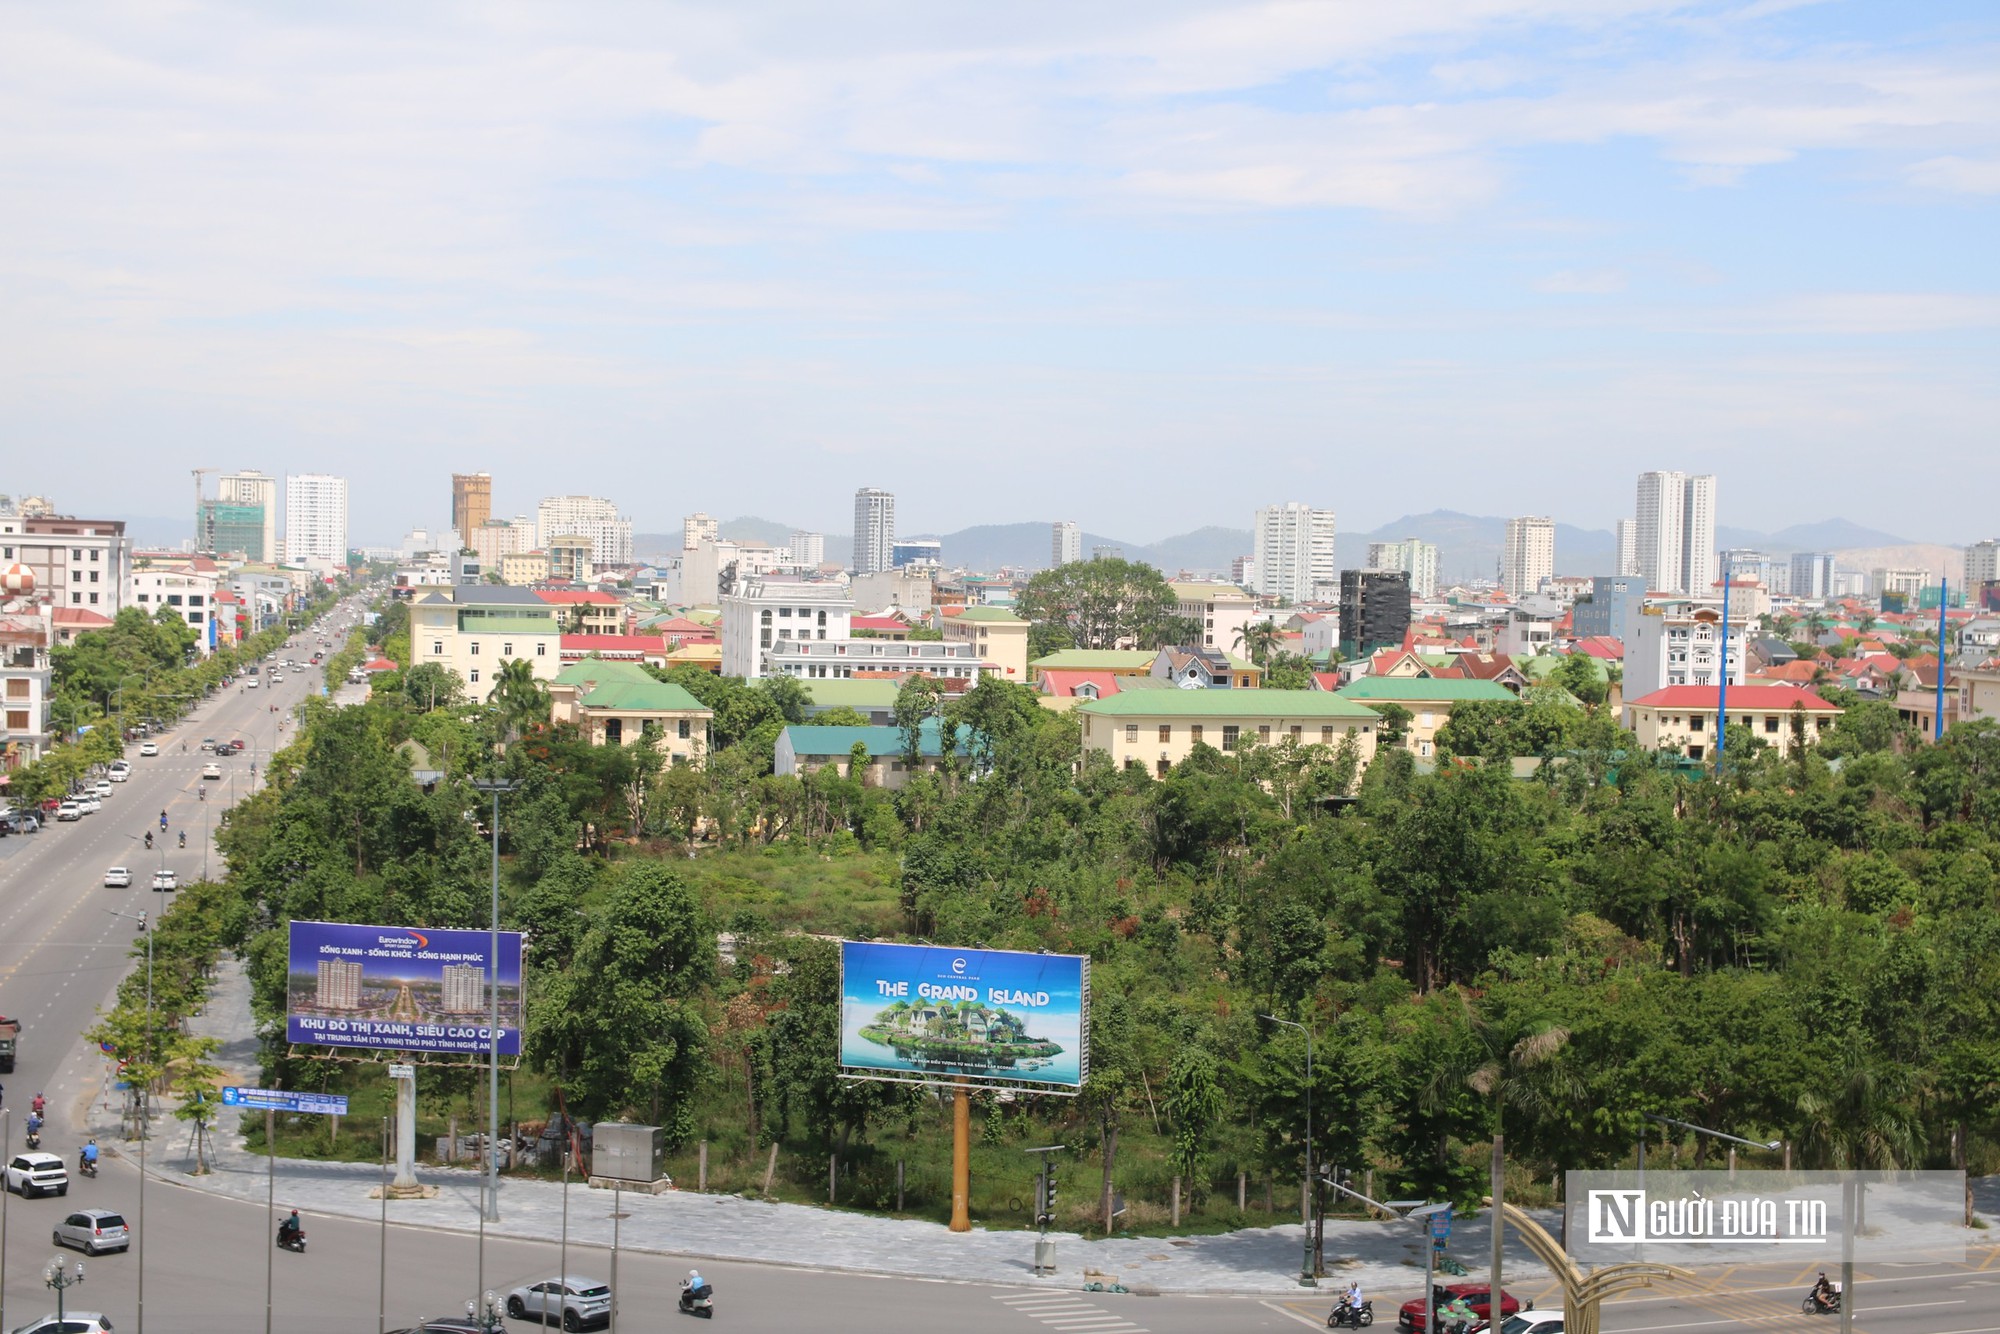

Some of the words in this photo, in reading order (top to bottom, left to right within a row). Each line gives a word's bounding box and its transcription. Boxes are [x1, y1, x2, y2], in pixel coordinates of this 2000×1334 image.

[378, 936, 418, 945] Eurowindow
[320, 944, 340, 954] SỐNG
[368, 948, 390, 957] SỐNG
[391, 950, 412, 958] KHỎE
[418, 950, 439, 960] SỐNG
[440, 953, 461, 962] HẠNH
[463, 953, 483, 961] PHÚC
[876, 980, 908, 997] THE
[918, 982, 978, 1002] GRAND
[988, 987, 1049, 1007] ISLAND
[300, 1018, 326, 1030] KHU
[328, 1019, 348, 1031] ĐÔ
[350, 1022, 371, 1035] THỊ
[374, 1024, 414, 1037] XANH,
[416, 1023, 445, 1037] SIÊU
[448, 1028, 475, 1038] CAO
[314, 1033, 325, 1042] TẠI
[352, 1034, 368, 1043] TÂM
[457, 1040, 478, 1050] NGHỆ
